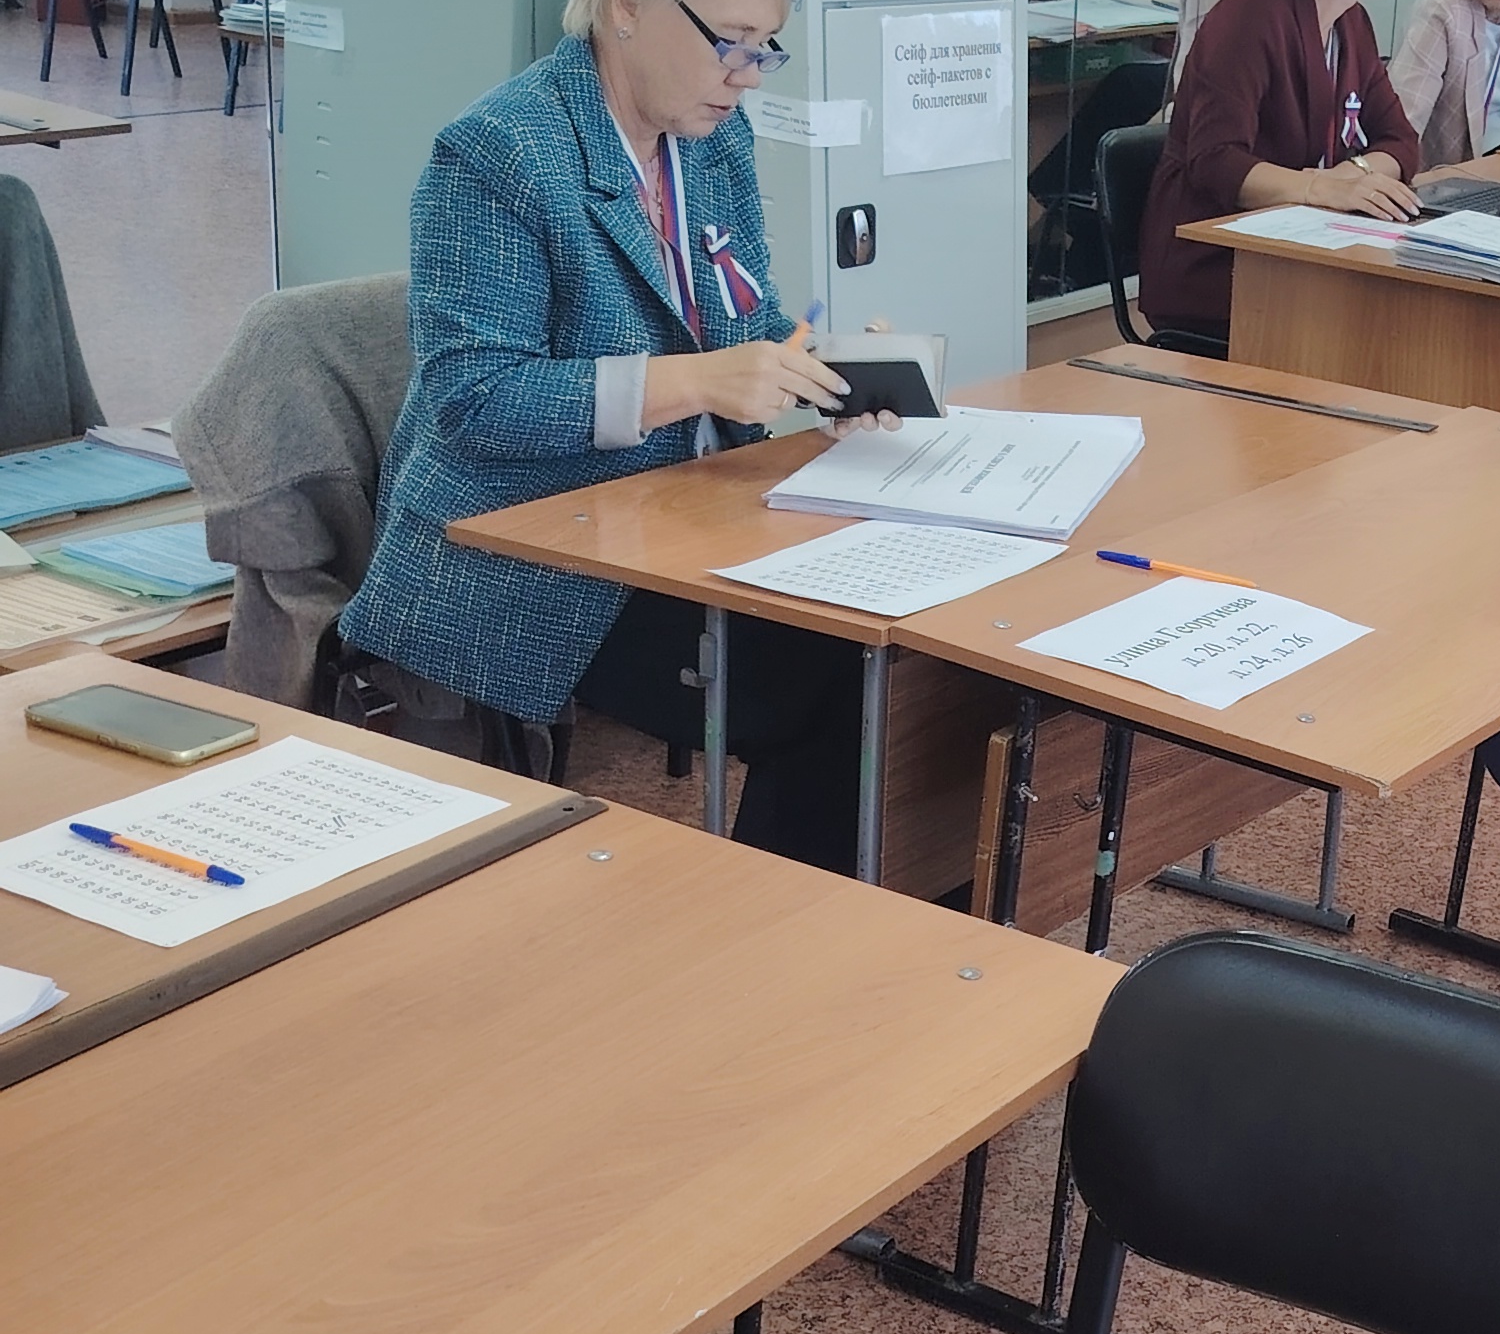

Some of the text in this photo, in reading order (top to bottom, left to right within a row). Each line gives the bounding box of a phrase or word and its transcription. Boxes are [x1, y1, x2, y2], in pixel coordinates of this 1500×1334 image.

[894, 41, 1002, 64] Сейф для хранения
[907, 67, 992, 88] сейф-пакетов с
[912, 92, 987, 111] бюллетенями
[1104, 596, 1258, 668] улица Георгиева
[1181, 622, 1279, 668] д. 20, д. 22,
[1228, 632, 1314, 680] д. 24, д. 26
